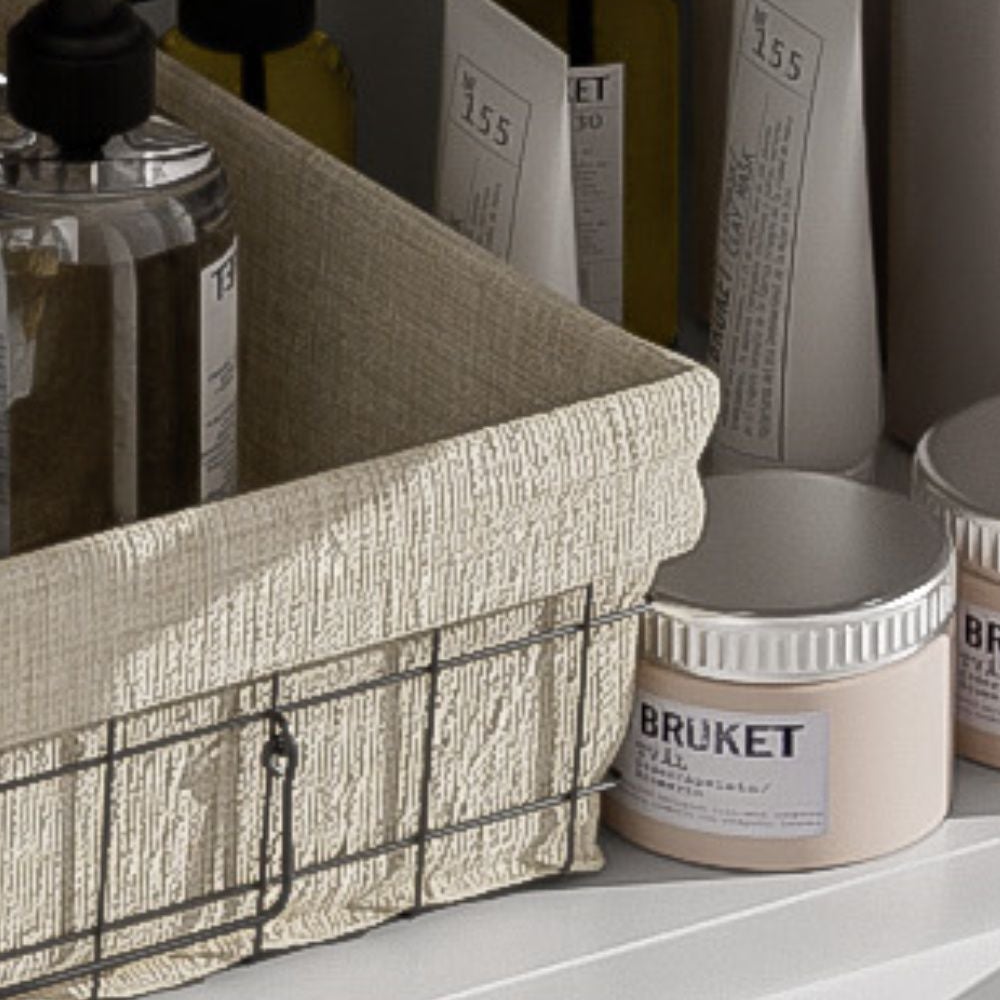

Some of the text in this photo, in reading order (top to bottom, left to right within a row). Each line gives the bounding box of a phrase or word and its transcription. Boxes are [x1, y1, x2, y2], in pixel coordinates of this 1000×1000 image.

[752, 27, 803, 81] 155
[461, 92, 510, 147] 155
[640, 702, 805, 758] BRUKET
